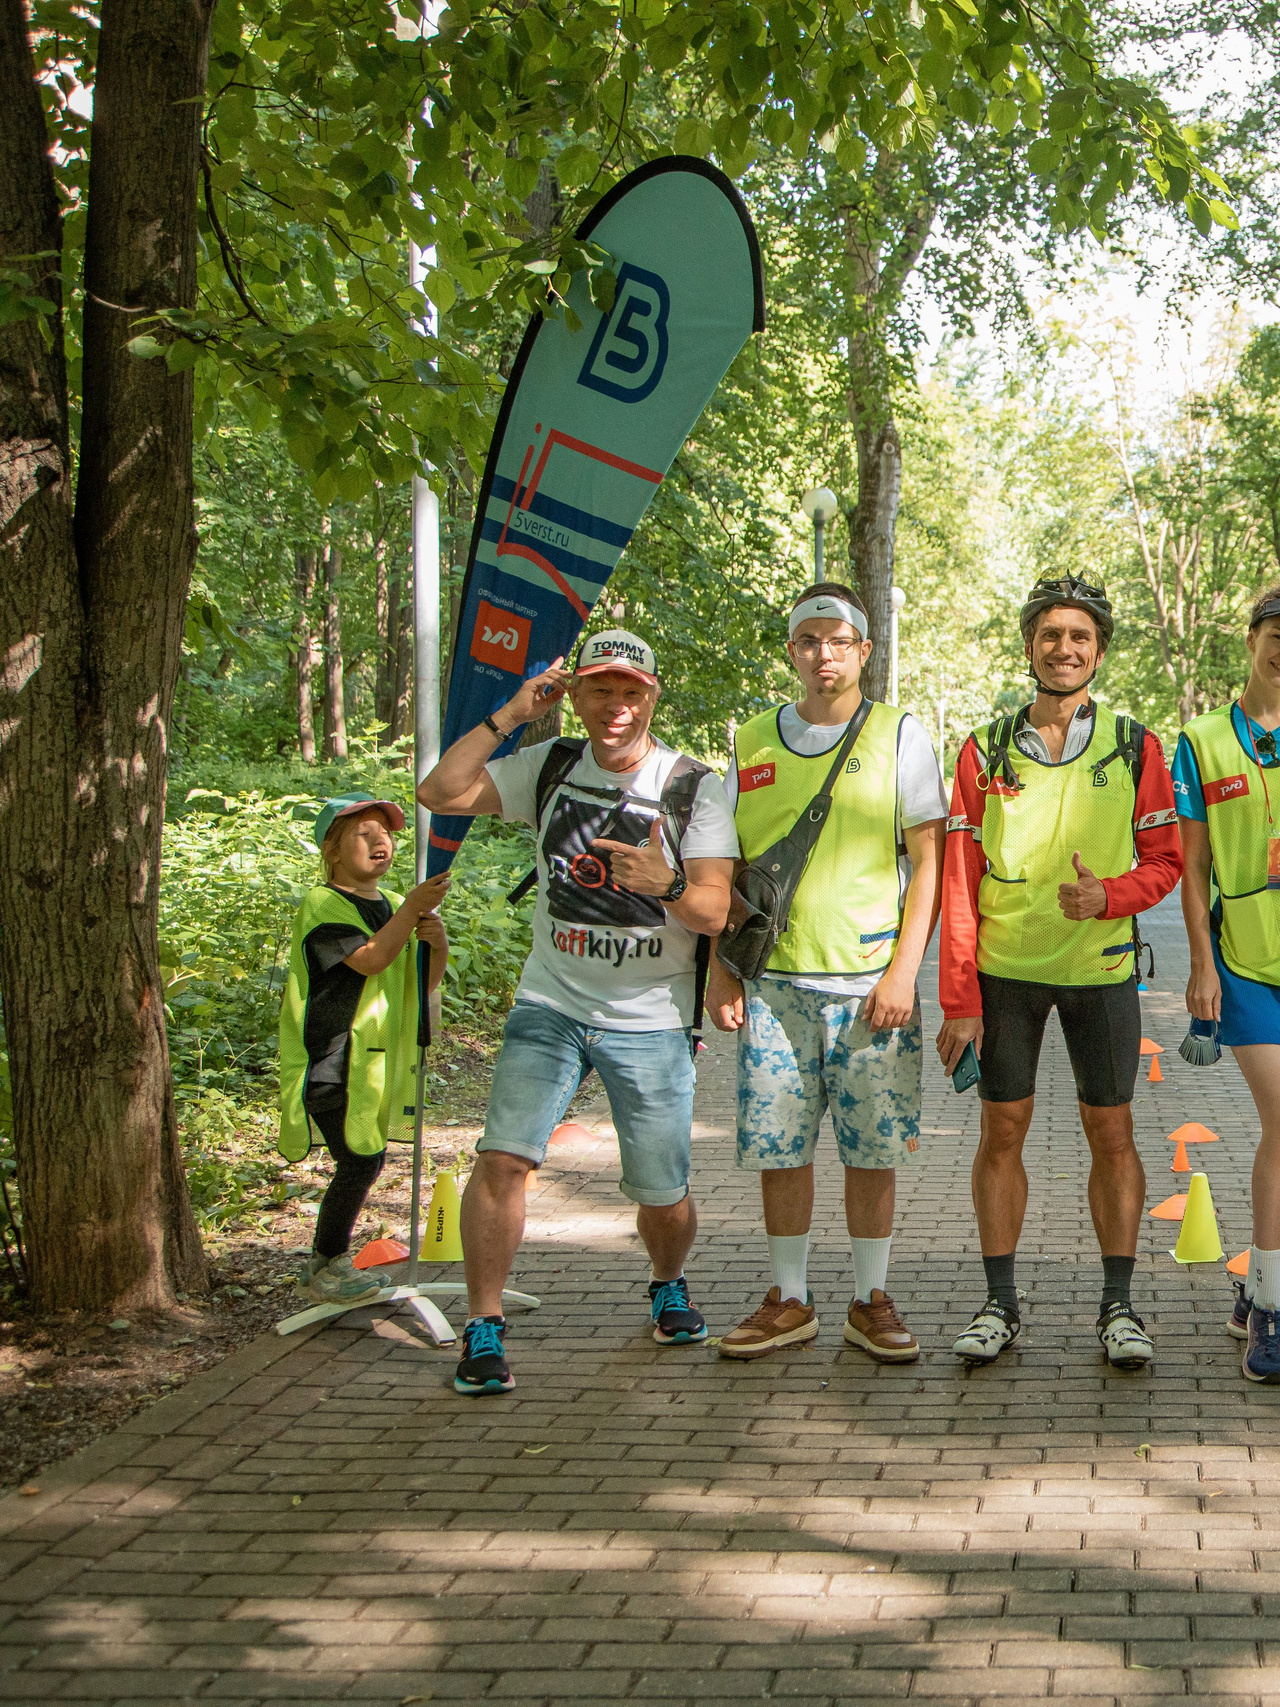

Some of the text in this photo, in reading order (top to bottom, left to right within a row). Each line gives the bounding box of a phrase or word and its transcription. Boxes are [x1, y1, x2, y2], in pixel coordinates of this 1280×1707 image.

[514, 511, 570, 548] 5verst.ru
[592, 640, 646, 658] TOMMY
[613, 651, 645, 665] JEANS
[1172, 780, 1190, 795] СБ
[1109, 1308, 1130, 1318] GIRO
